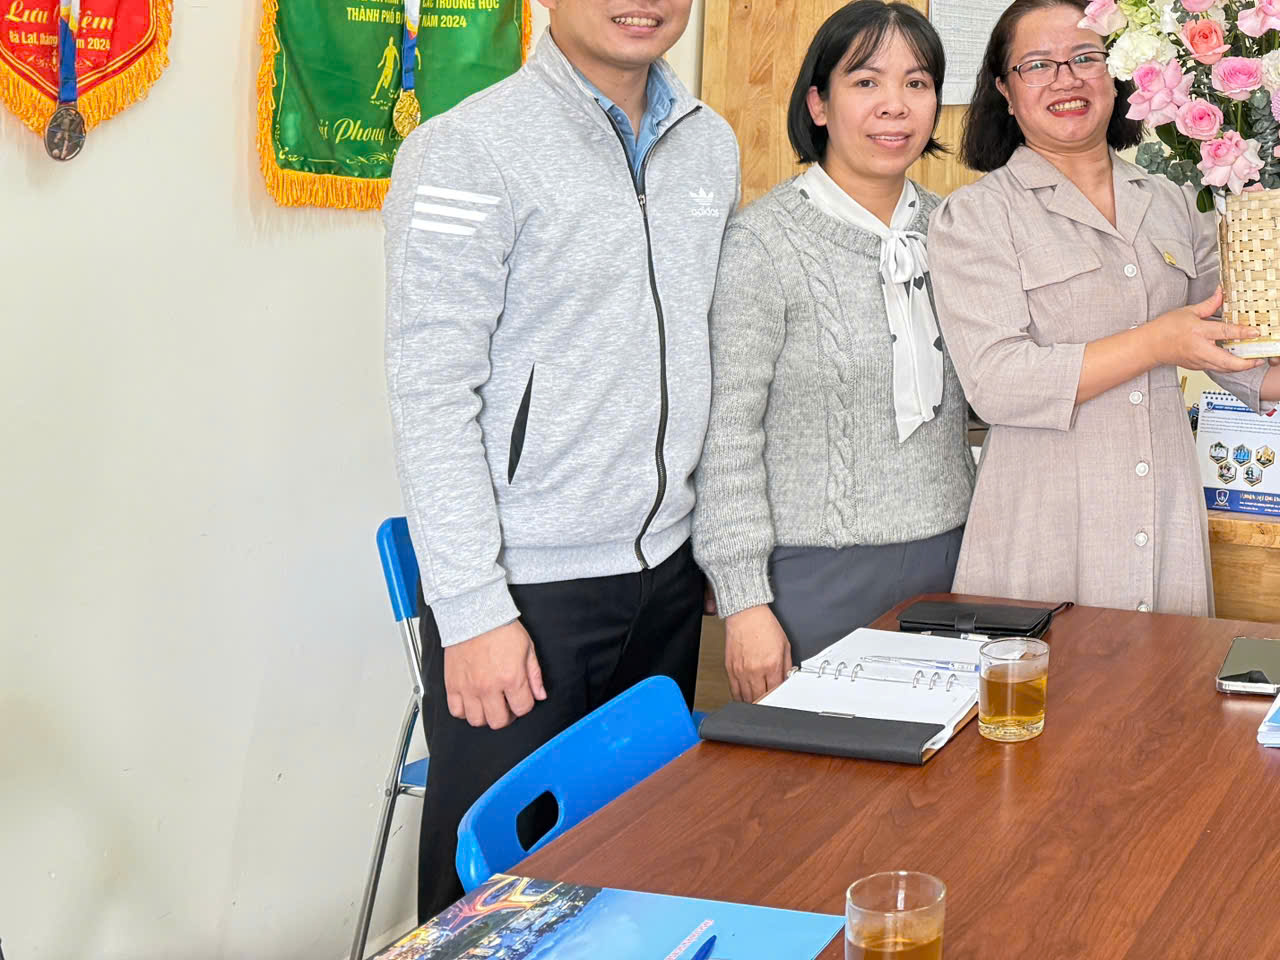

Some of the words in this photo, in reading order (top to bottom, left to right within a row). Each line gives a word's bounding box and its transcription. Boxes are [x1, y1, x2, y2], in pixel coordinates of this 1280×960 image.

[346, 5, 380, 22] THÀNH
[381, 6, 394, 24] PHỐ
[440, 15, 467, 28] 2024
[88, 37, 111, 50] 2024
[333, 117, 386, 146] Phong
